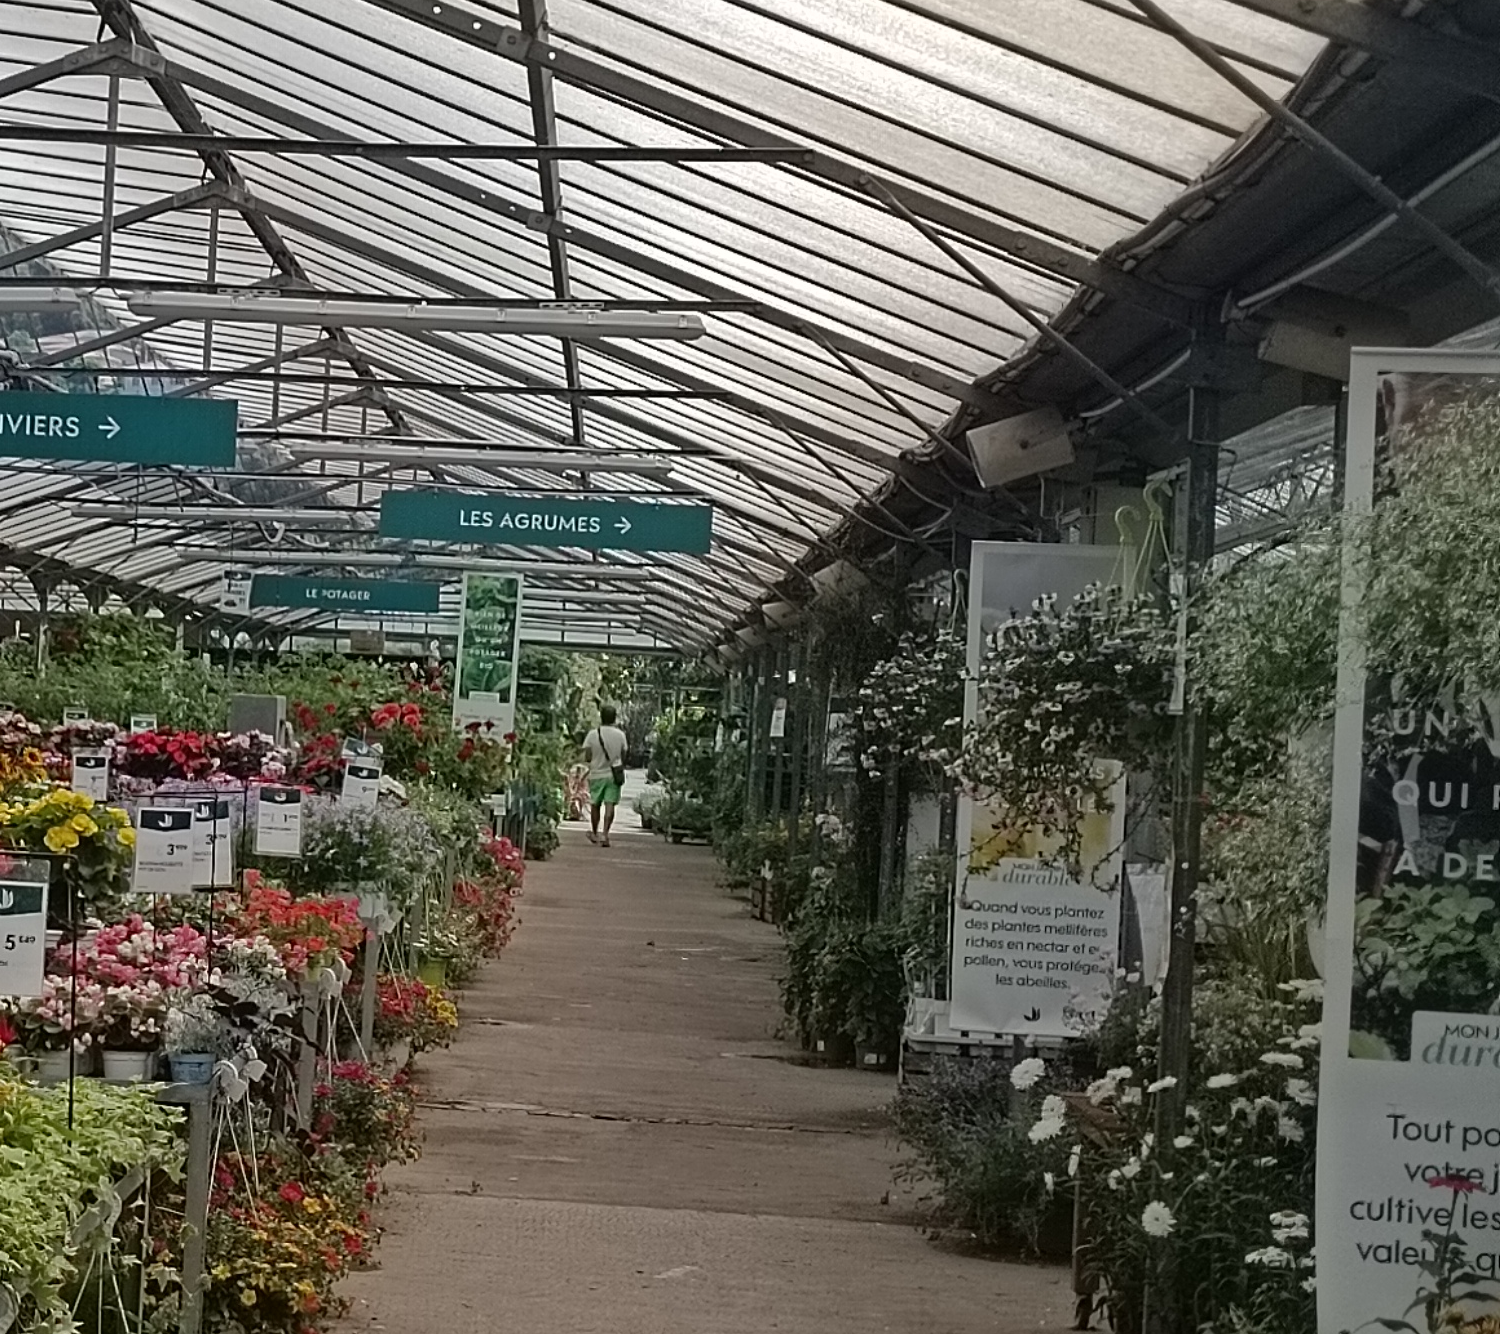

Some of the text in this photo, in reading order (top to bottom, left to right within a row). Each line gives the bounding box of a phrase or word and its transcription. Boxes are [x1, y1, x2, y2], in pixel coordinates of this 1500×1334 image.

[459, 509, 601, 533] LES AGRUMES
[305, 588, 371, 601] LE POTAGER
[1393, 709, 1449, 736] UN
[1392, 779, 1468, 809] QUI
[1443, 852, 1495, 881] DE
[970, 899, 1105, 920] Quand vous plantez
[964, 918, 989, 930] des
[991, 919, 1041, 933] plantes
[4, 934, 16, 951] 5
[965, 936, 1004, 950] riches
[1007, 941, 1024, 951] en
[1026, 941, 1070, 953] nectar
[1072, 943, 1085, 954] et
[964, 955, 1009, 968] pollen,
[1012, 959, 1043, 970] vous
[996, 974, 1013, 986] les
[1445, 1024, 1489, 1039] MON
[1386, 1114, 1500, 1152] Tout po
[1350, 1195, 1500, 1231] cultive les
[1356, 1240, 1466, 1269] vale
